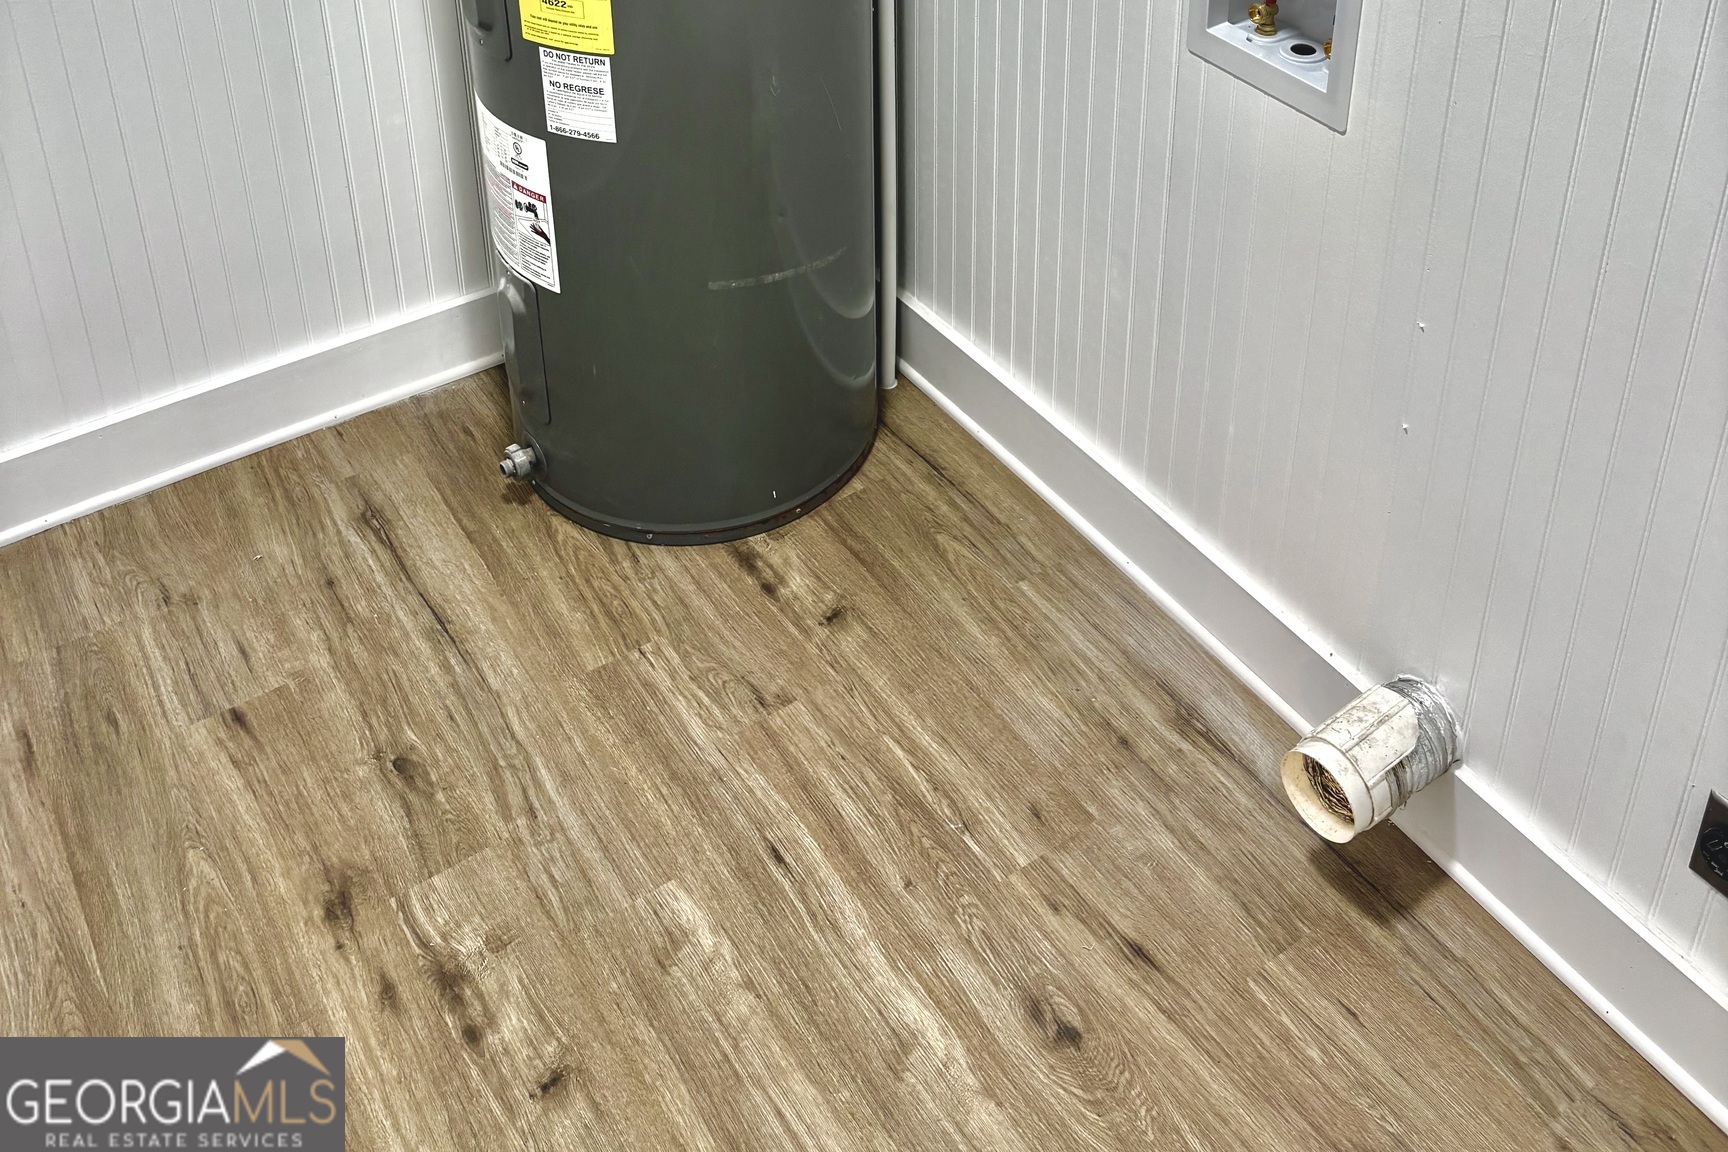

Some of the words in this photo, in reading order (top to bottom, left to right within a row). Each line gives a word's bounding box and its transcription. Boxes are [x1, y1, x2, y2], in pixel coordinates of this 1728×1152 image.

[543, 50, 554, 59] DO
[556, 52, 571, 62] NOT
[573, 55, 606, 67] RETURN
[549, 79, 561, 89] NO
[563, 82, 605, 96] REGRESE
[549, 124, 601, 140] 1-866-279-4566
[518, 187, 545, 202] DANGER
